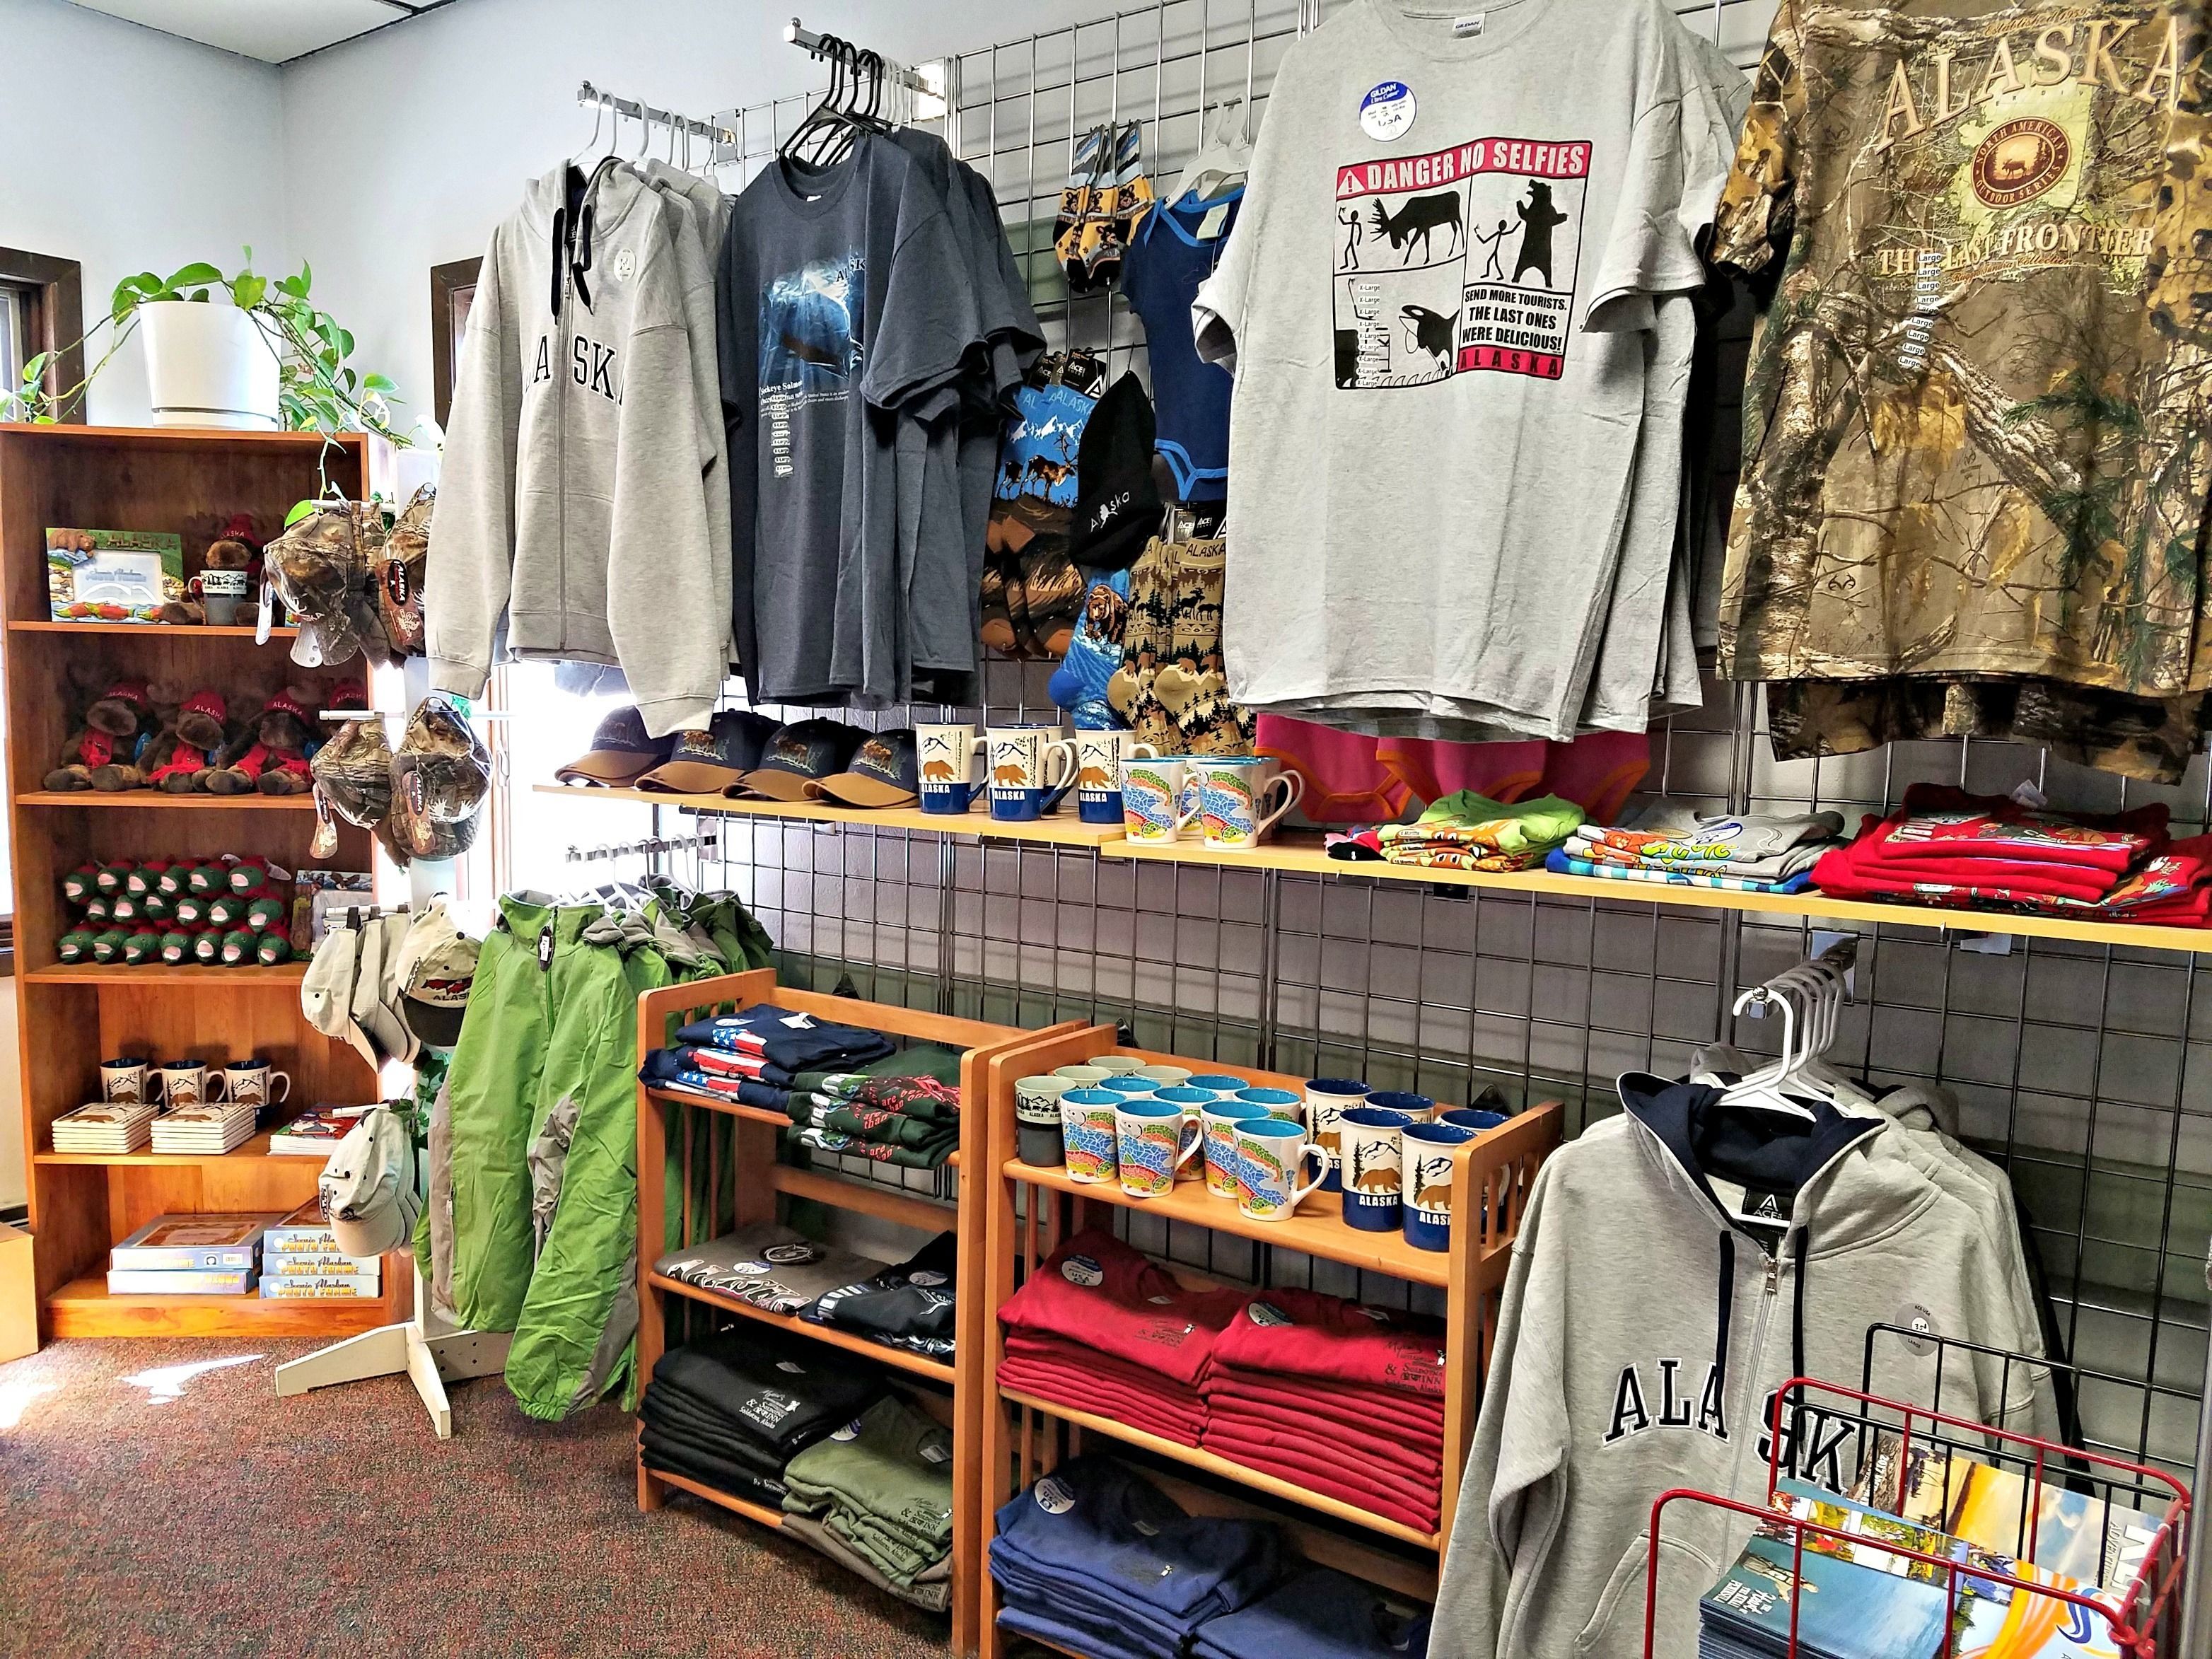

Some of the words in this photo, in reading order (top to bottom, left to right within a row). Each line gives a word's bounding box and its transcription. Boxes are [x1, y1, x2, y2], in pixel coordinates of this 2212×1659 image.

[1370, 83, 1397, 98] GILDAN
[1875, 15, 2182, 155] ALASKA
[1976, 129, 2008, 163] NORTH
[2012, 120, 2066, 151] AMERICAN
[1366, 153, 1455, 190] DANGER
[1460, 142, 1485, 173] NO
[1493, 141, 1584, 175] SELFIES
[1976, 179, 2015, 203] OUTDOOR
[2019, 165, 2061, 199] SERIES
[1945, 234, 1998, 272] LAST
[2001, 223, 2156, 257] FRONTIER
[1919, 254, 1941, 263] Large
[1918, 268, 1940, 276] Large
[1917, 282, 1940, 291] Large
[1465, 289, 1487, 303] SEND
[1489, 289, 1516, 303] MORE
[1518, 293, 1567, 310] TOURISTS.
[1469, 306, 1491, 322] THE
[1494, 307, 1523, 325] LAST
[1525, 312, 1556, 330] ONES
[1911, 317, 1933, 328] Large
[1462, 327, 1493, 344] WERE
[1496, 327, 1563, 351] DELICIOUS!
[1908, 330, 1929, 342] Large
[1904, 343, 1925, 355] Large
[1460, 349, 1558, 376] ALASKA
[1899, 356, 1921, 368] Large
[107, 534, 177, 548] ALASKA
[1186, 543, 1227, 557] ALASKA
[397, 564, 406, 602] ALASKA
[194, 704, 224, 721] ALASKA
[272, 701, 303, 717] ALASKA
[921, 784, 950, 793] ALASKA
[994, 790, 1025, 801] ALASKA
[1079, 792, 1107, 803] ALASKA
[433, 992, 470, 1001] ALAS
[881, 1095, 897, 1107] are
[863, 1111, 882, 1120] are
[864, 1114, 889, 1129] than
[869, 1144, 885, 1156] are
[1358, 1195, 1398, 1206] ALASKA
[1754, 1209, 1779, 1219] ACE
[281, 1242, 318, 1252] PHOTO
[281, 1266, 318, 1275] PHOTO
[322, 1266, 359, 1275] FRAME
[277, 1288, 315, 1297] PHOTO
[320, 1288, 359, 1297] FRAME
[1385, 1363, 1397, 1375] &
[746, 1398, 757, 1408] &
[901, 1507, 912, 1518] &
